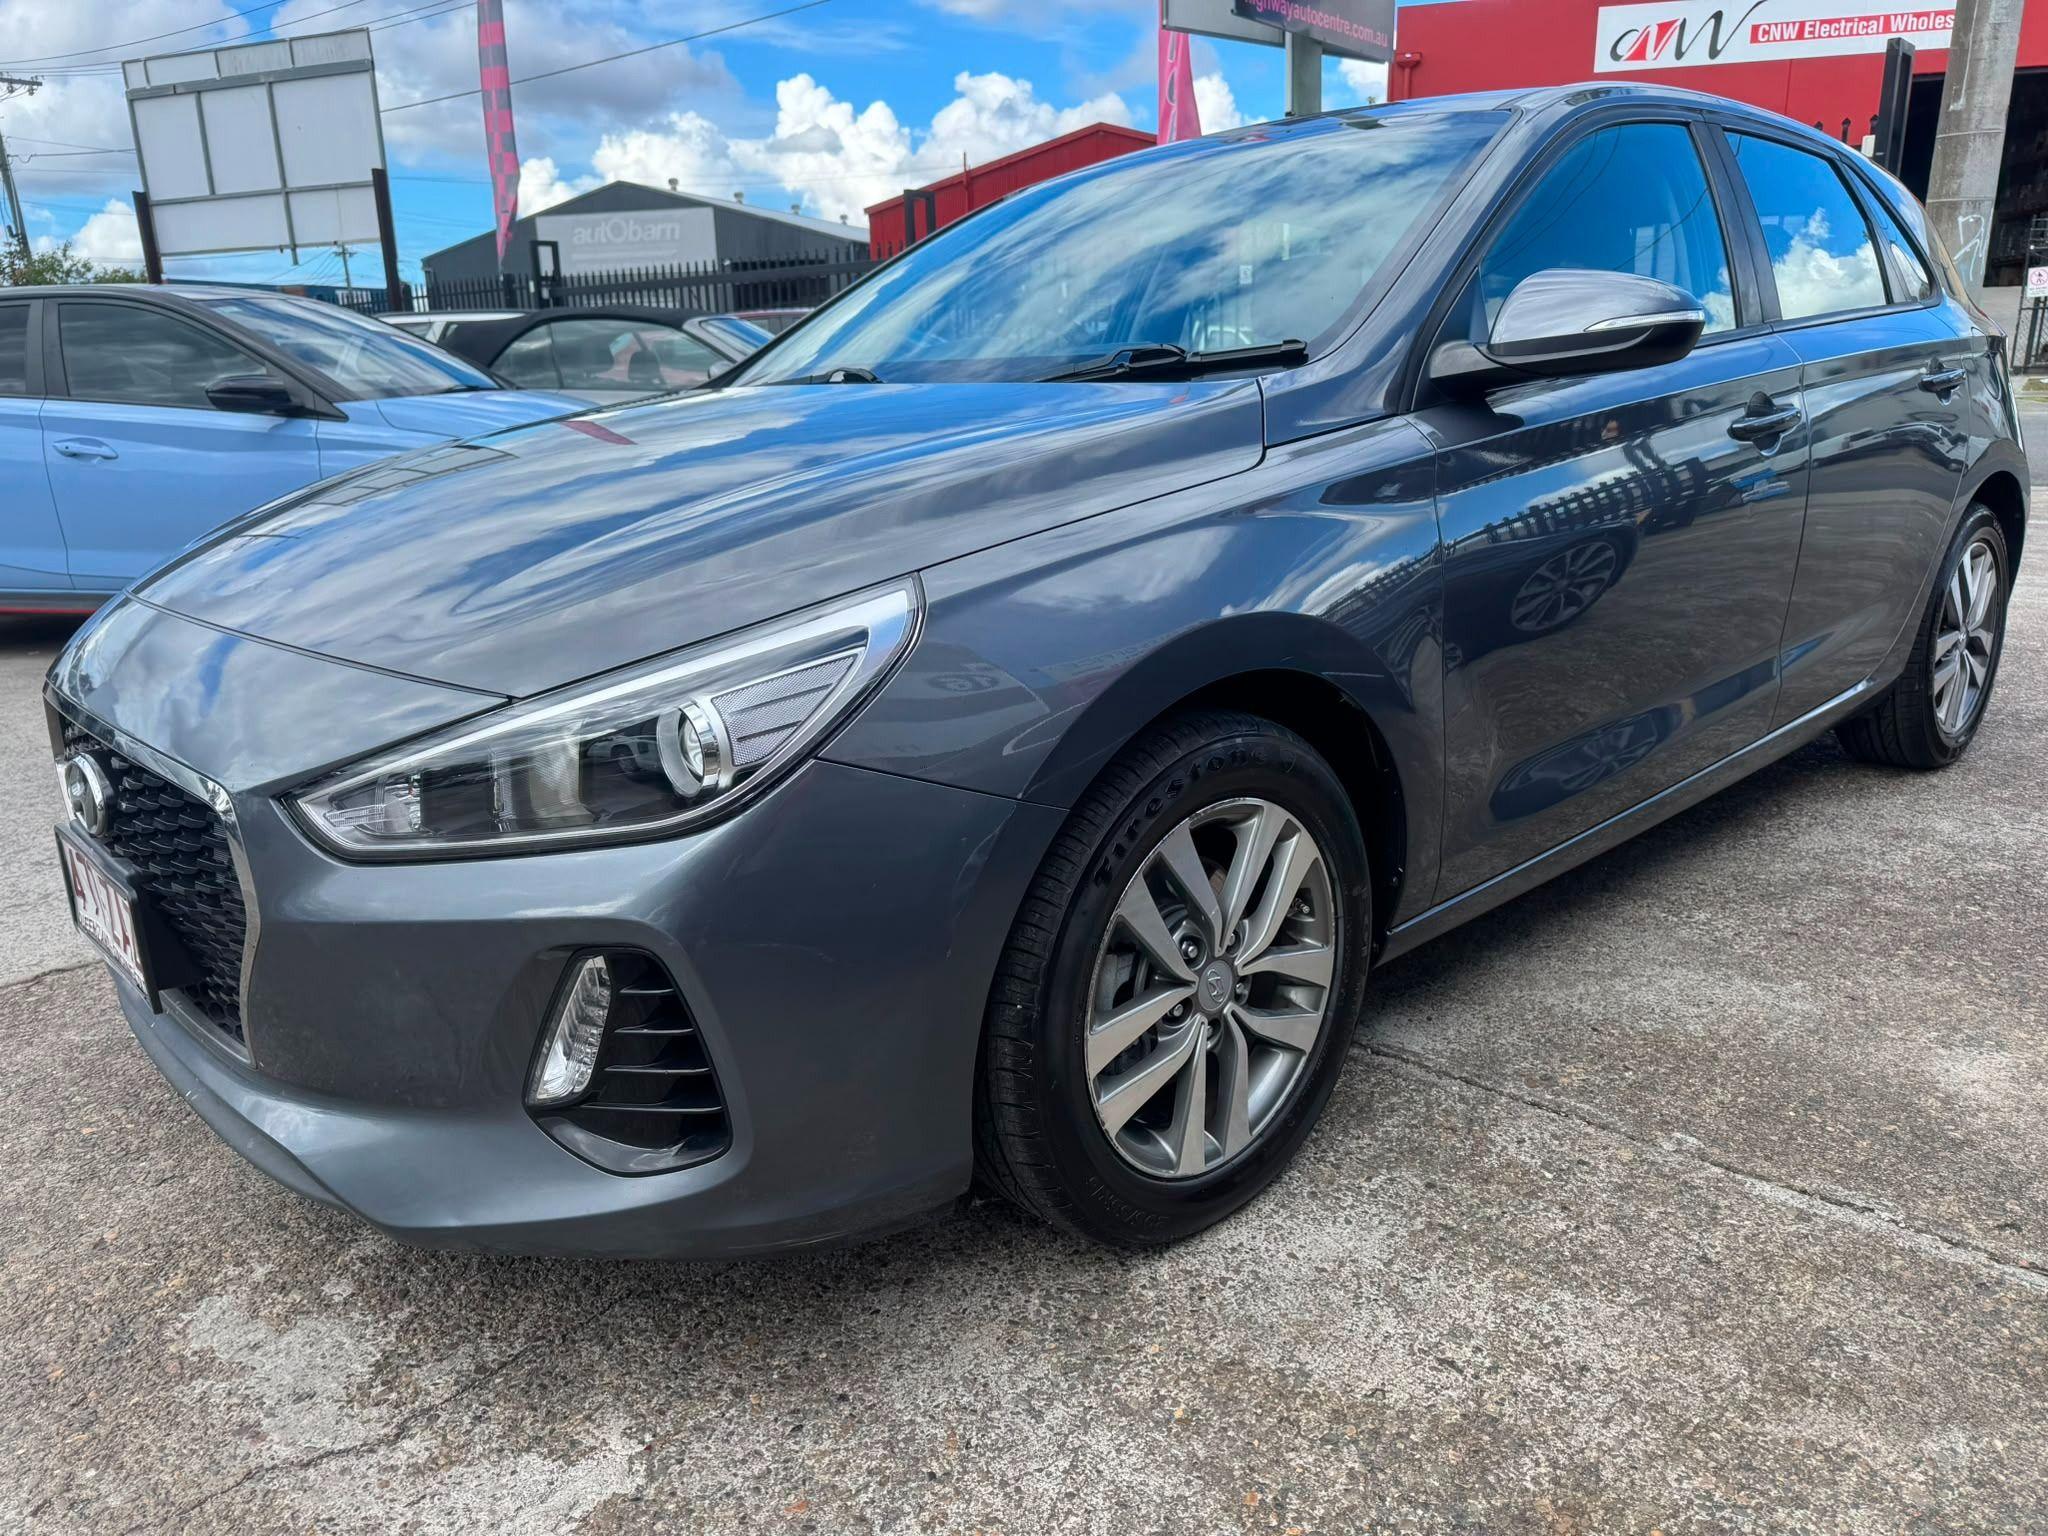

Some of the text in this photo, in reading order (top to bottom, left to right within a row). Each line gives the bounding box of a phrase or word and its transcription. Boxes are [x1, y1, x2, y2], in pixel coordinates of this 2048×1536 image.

[1245, 0, 1388, 48] ghwayautocentre.com.au
[1757, 22, 1799, 42] CNW
[1803, 15, 1884, 39] Electrical
